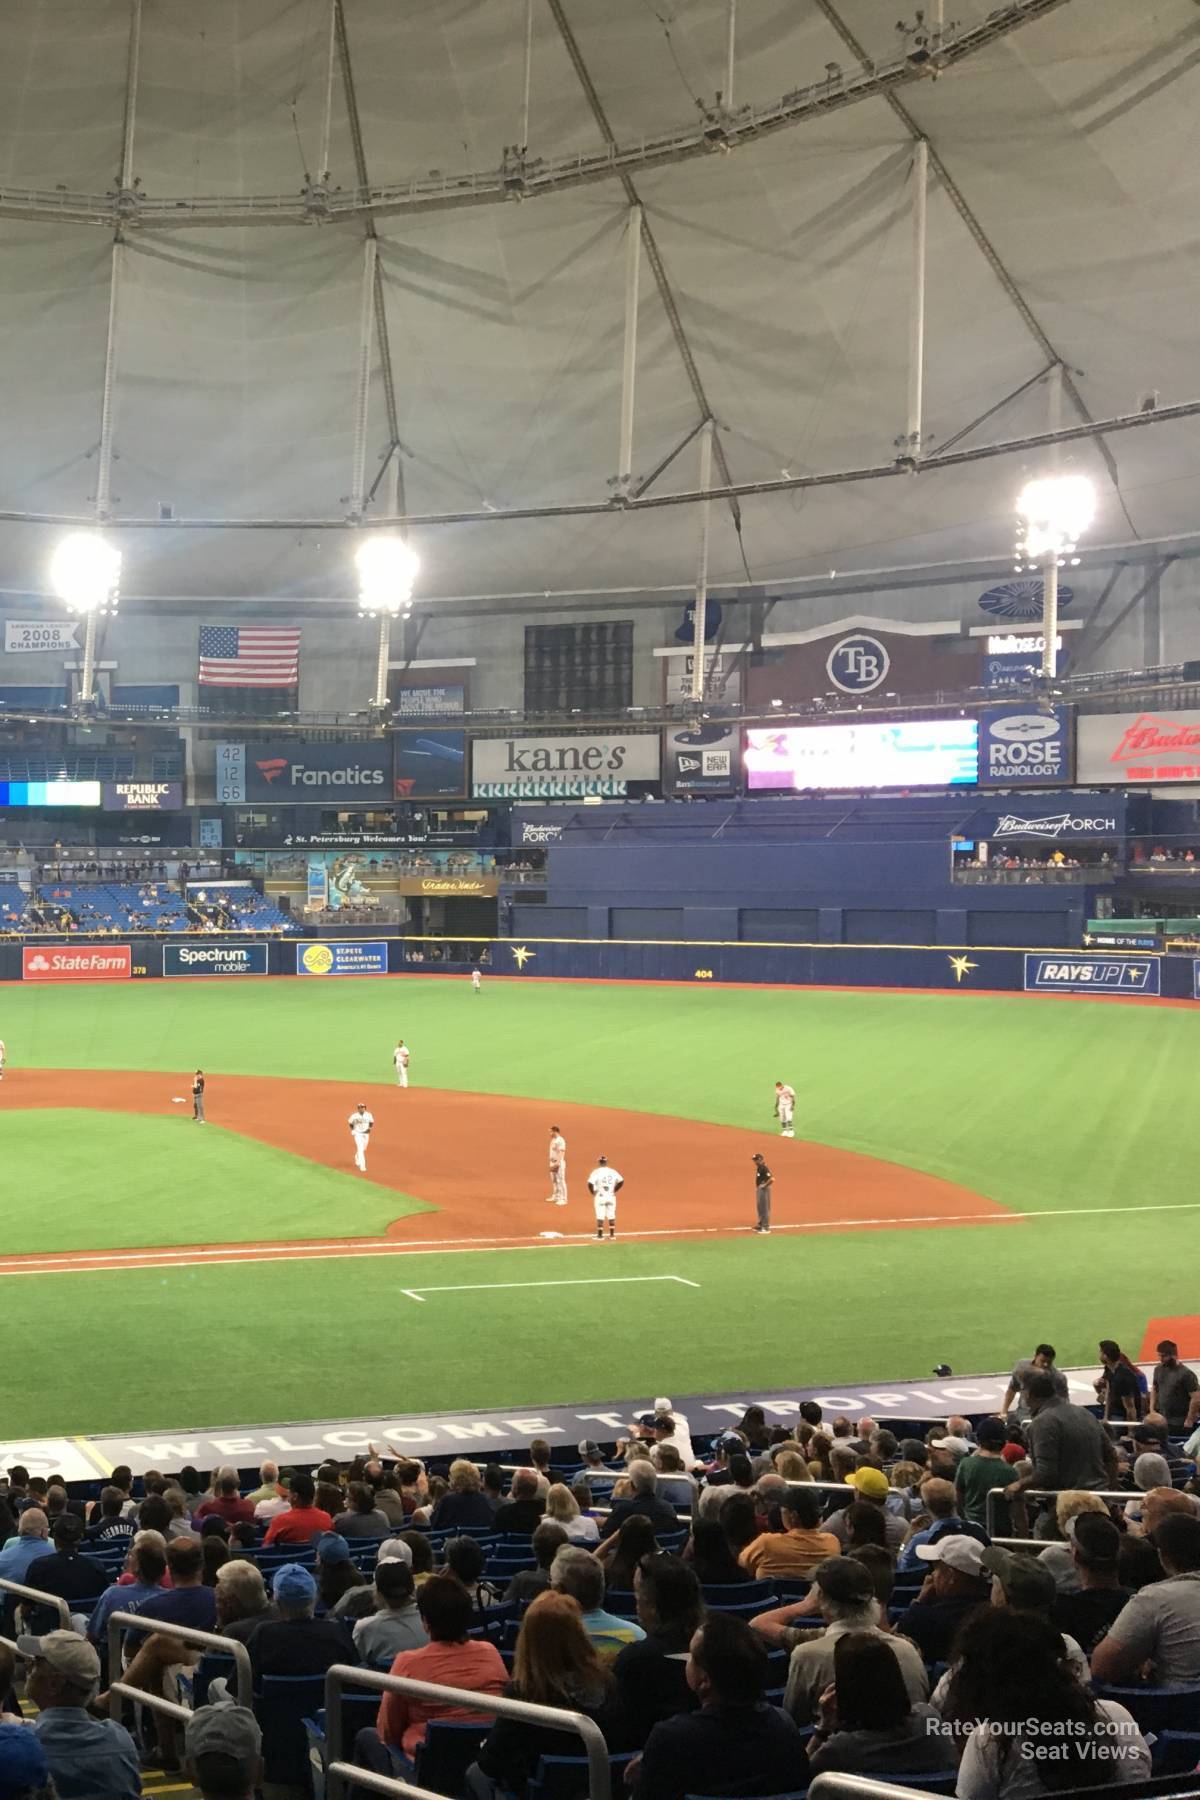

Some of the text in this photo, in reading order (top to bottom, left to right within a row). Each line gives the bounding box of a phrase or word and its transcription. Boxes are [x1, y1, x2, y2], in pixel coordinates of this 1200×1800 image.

[22, 629, 61, 642] 2008
[10, 641, 71, 650] CHAMPIONS
[838, 646, 880, 682] TB
[222, 747, 241, 761] 42
[504, 741, 627, 773] kane's
[706, 755, 728, 764] NEW
[989, 741, 1062, 765] ROSE
[224, 767, 240, 781] 12
[706, 763, 727, 772] ERA
[989, 764, 1060, 777] RADIOLOGY
[291, 764, 385, 786] Fanatics
[116, 783, 170, 795] REPUBLIC
[222, 785, 241, 800] 66
[127, 794, 159, 804] BANK
[1001, 818, 1063, 832] Budweiser
[1063, 818, 1116, 831] PORCH
[295, 834, 307, 843] St.
[310, 834, 360, 845] Petersburg
[363, 834, 406, 843] Welcomes
[408, 833, 428, 843] You!
[1126, 938, 1137, 946] THE
[179, 948, 248, 965] Spectrum
[214, 962, 247, 973] mobile
[124, 1417, 566, 1462] WELCOME
